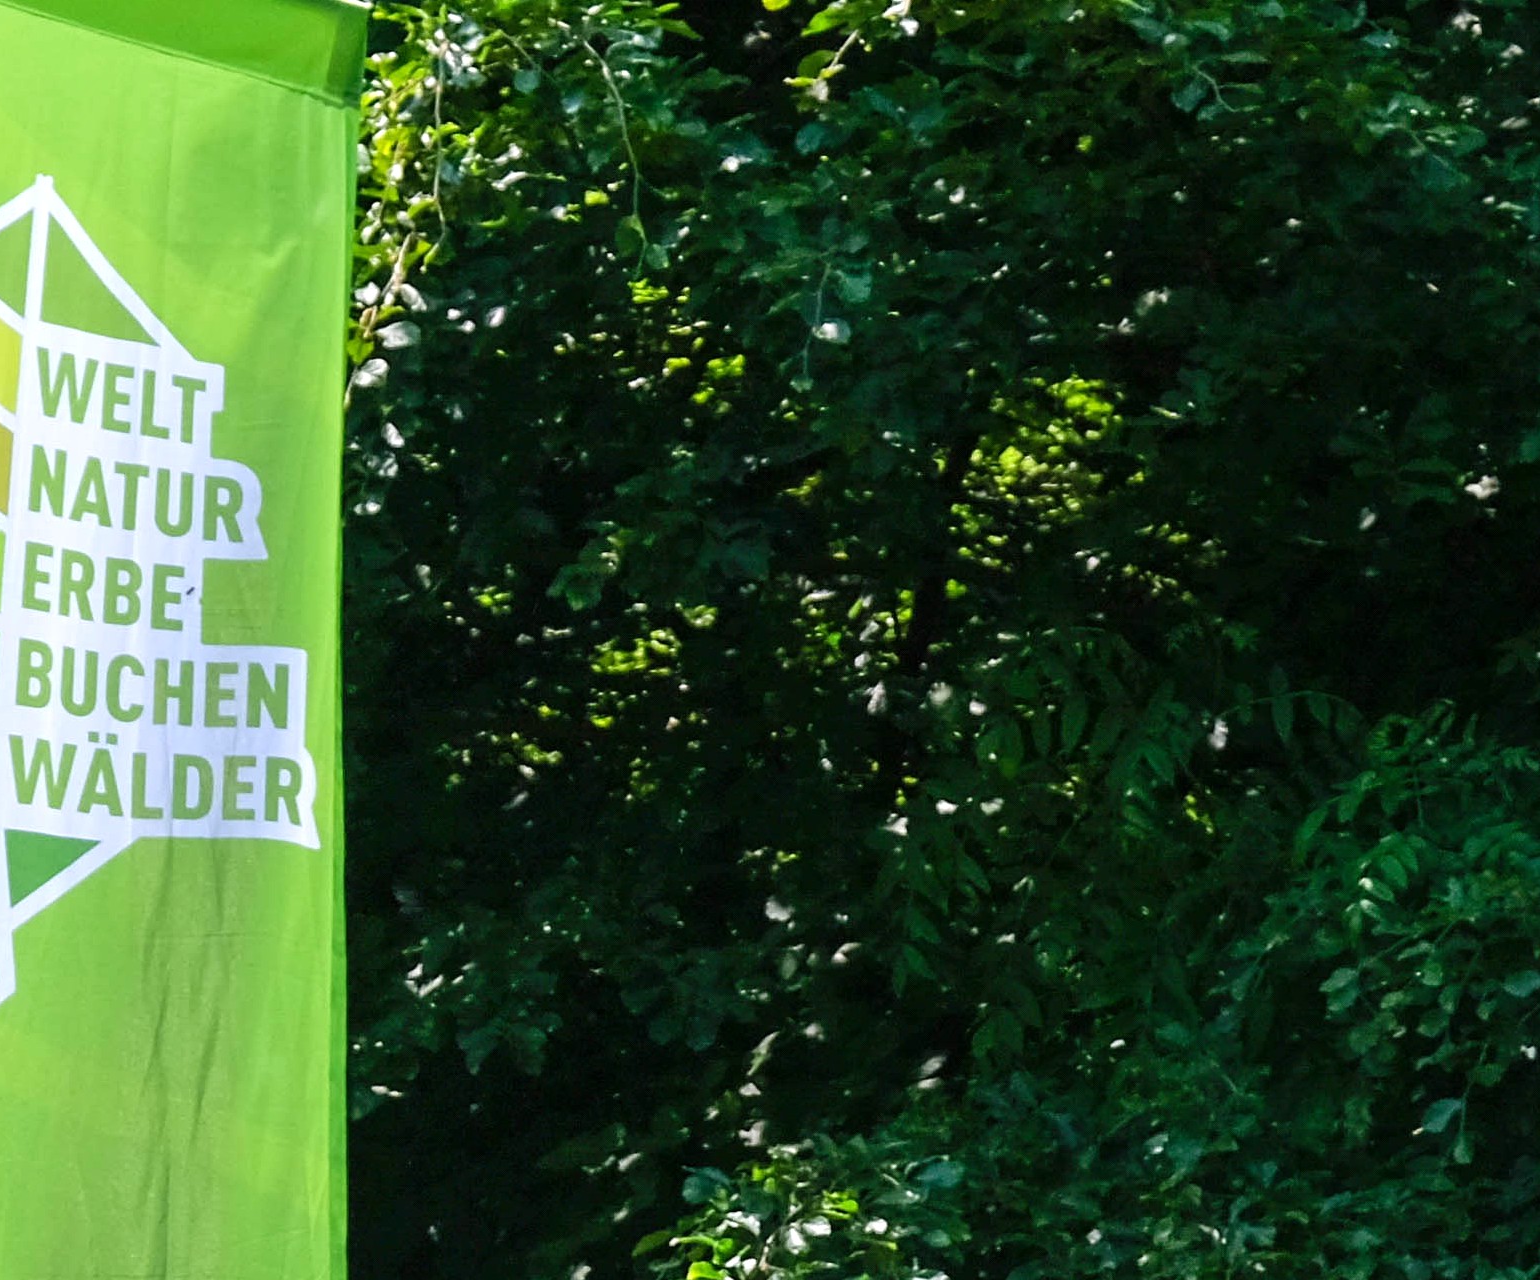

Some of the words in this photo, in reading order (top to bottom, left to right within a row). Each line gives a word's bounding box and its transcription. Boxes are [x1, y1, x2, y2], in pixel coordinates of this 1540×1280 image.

[37, 347, 205, 444] WELT
[27, 445, 244, 543] NATUR
[22, 543, 184, 631] ERBE
[16, 639, 289, 729] BUCHEN
[9, 731, 303, 827] WÄLDER
